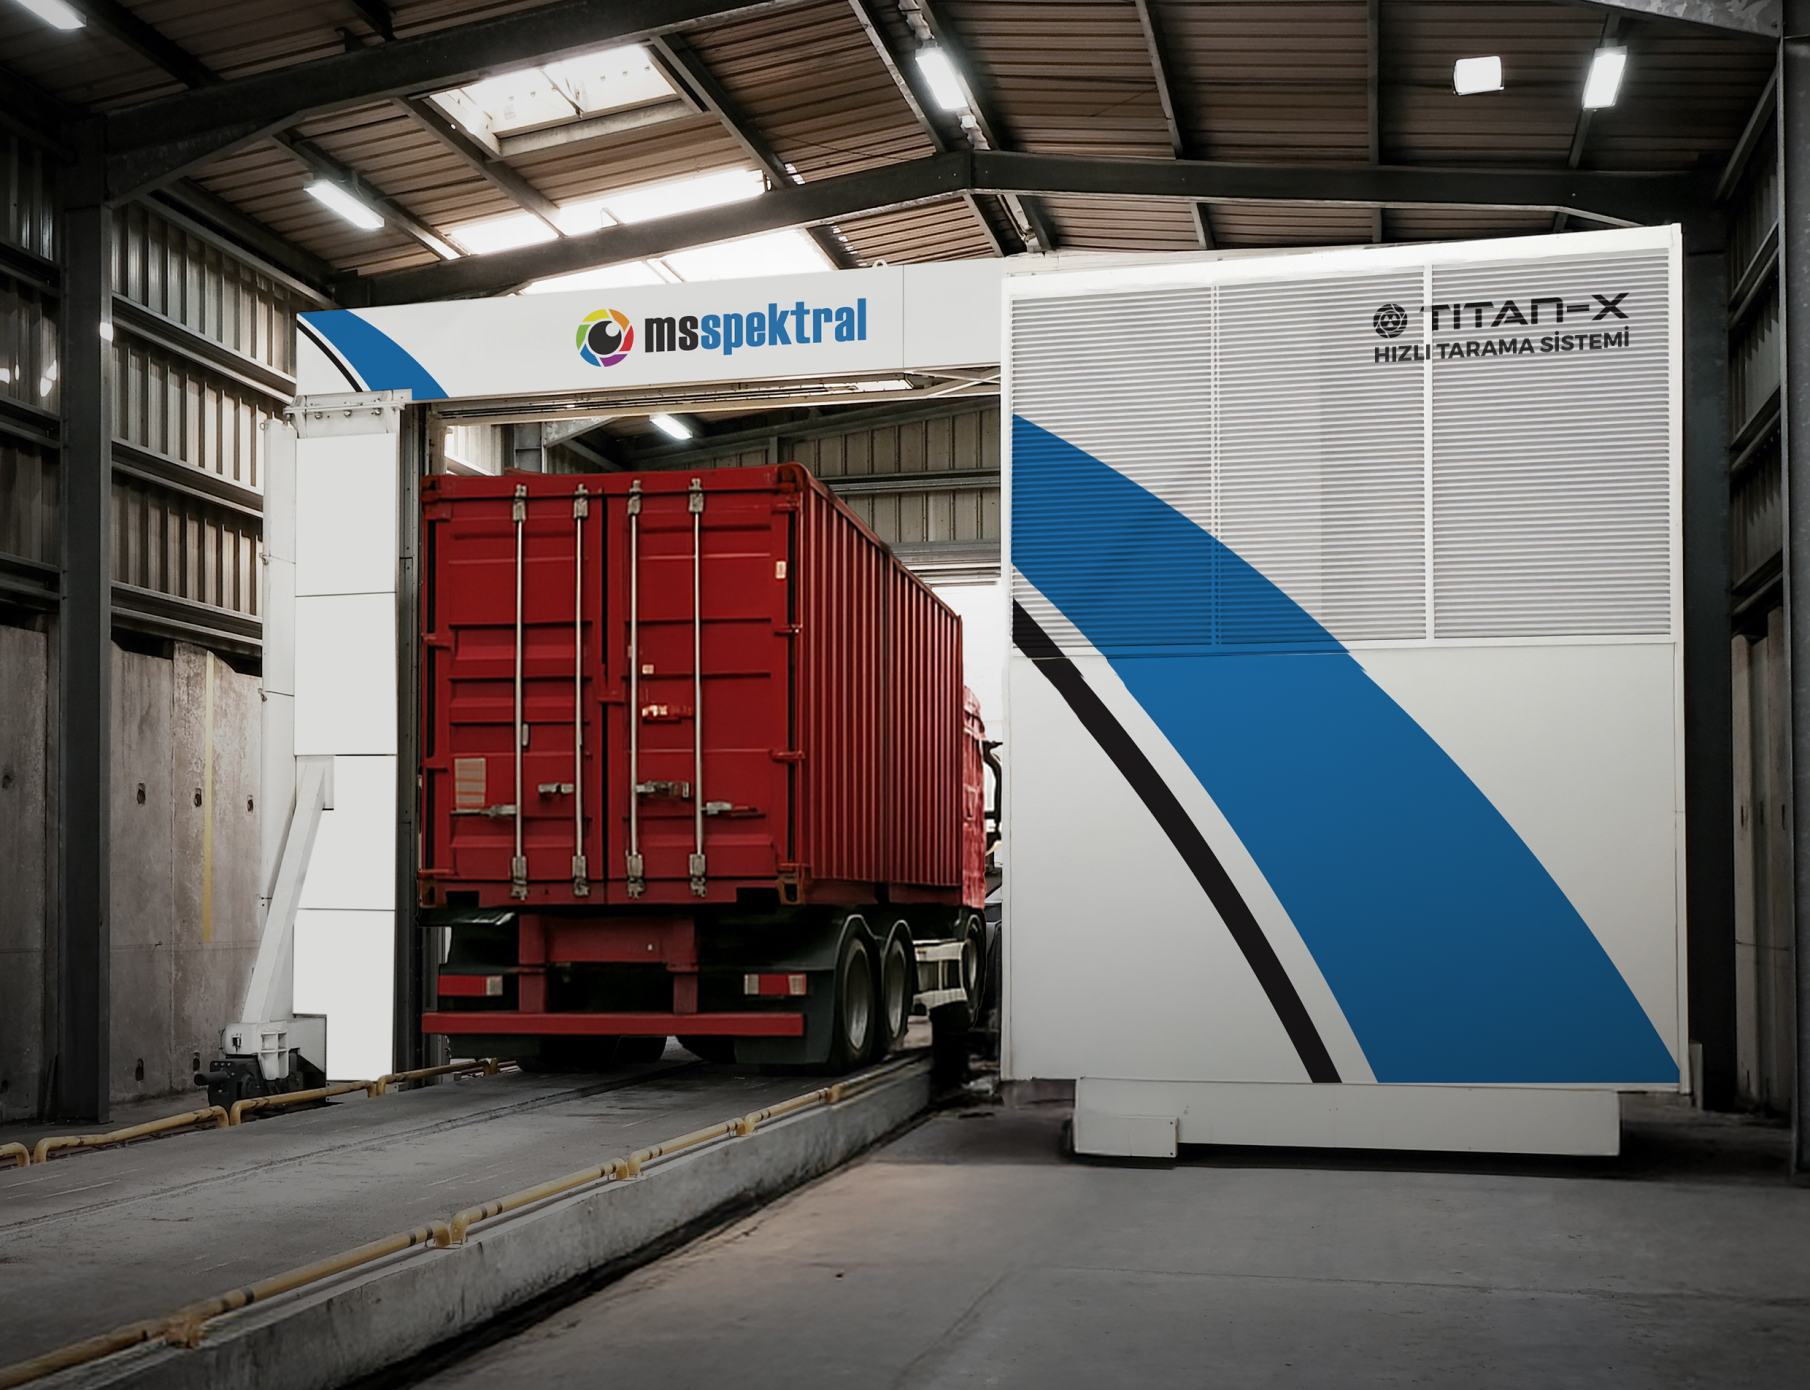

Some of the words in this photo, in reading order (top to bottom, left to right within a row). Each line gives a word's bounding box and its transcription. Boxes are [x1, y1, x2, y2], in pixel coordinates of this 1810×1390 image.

[645, 297, 867, 355] msspektral
[1420, 293, 1630, 331] TITAN-X
[1374, 344, 1431, 363] HIZLI
[1436, 339, 1534, 359] TARAMA
[1540, 326, 1629, 353] SİSTEMİ
